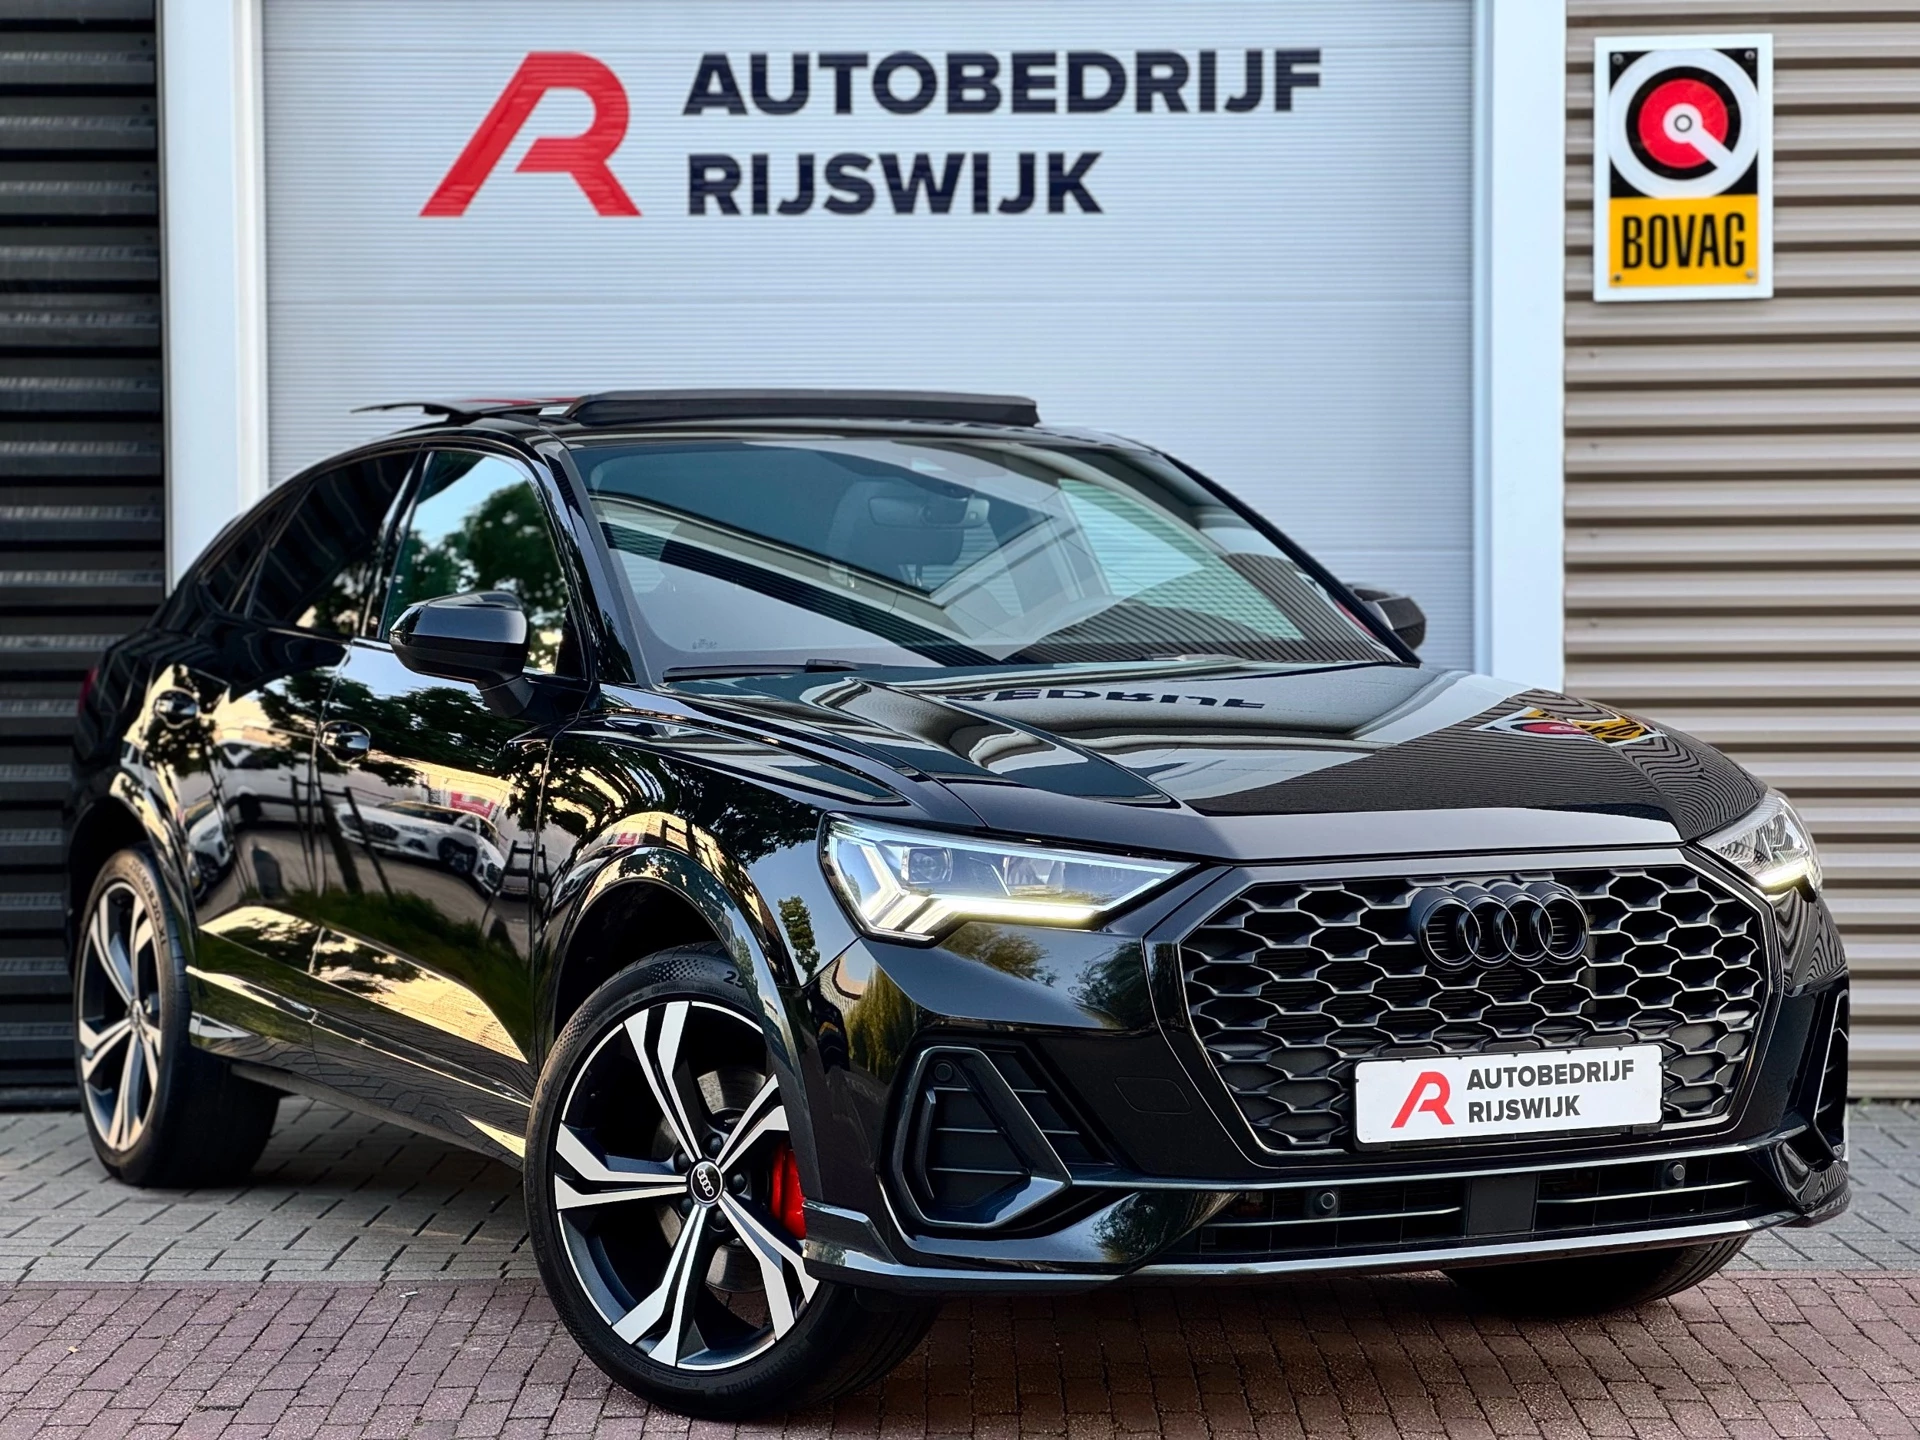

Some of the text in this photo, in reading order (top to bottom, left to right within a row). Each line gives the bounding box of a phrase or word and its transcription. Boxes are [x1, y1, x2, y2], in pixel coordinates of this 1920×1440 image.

[683, 49, 1321, 115] AUTOBEDRIJF
[688, 153, 1102, 217] RIJSWIJK
[1622, 212, 1745, 269] BOVAG
[1466, 1060, 1634, 1091] AUTOBEDRIJF
[1468, 1095, 1581, 1123] RIJSWIJK
